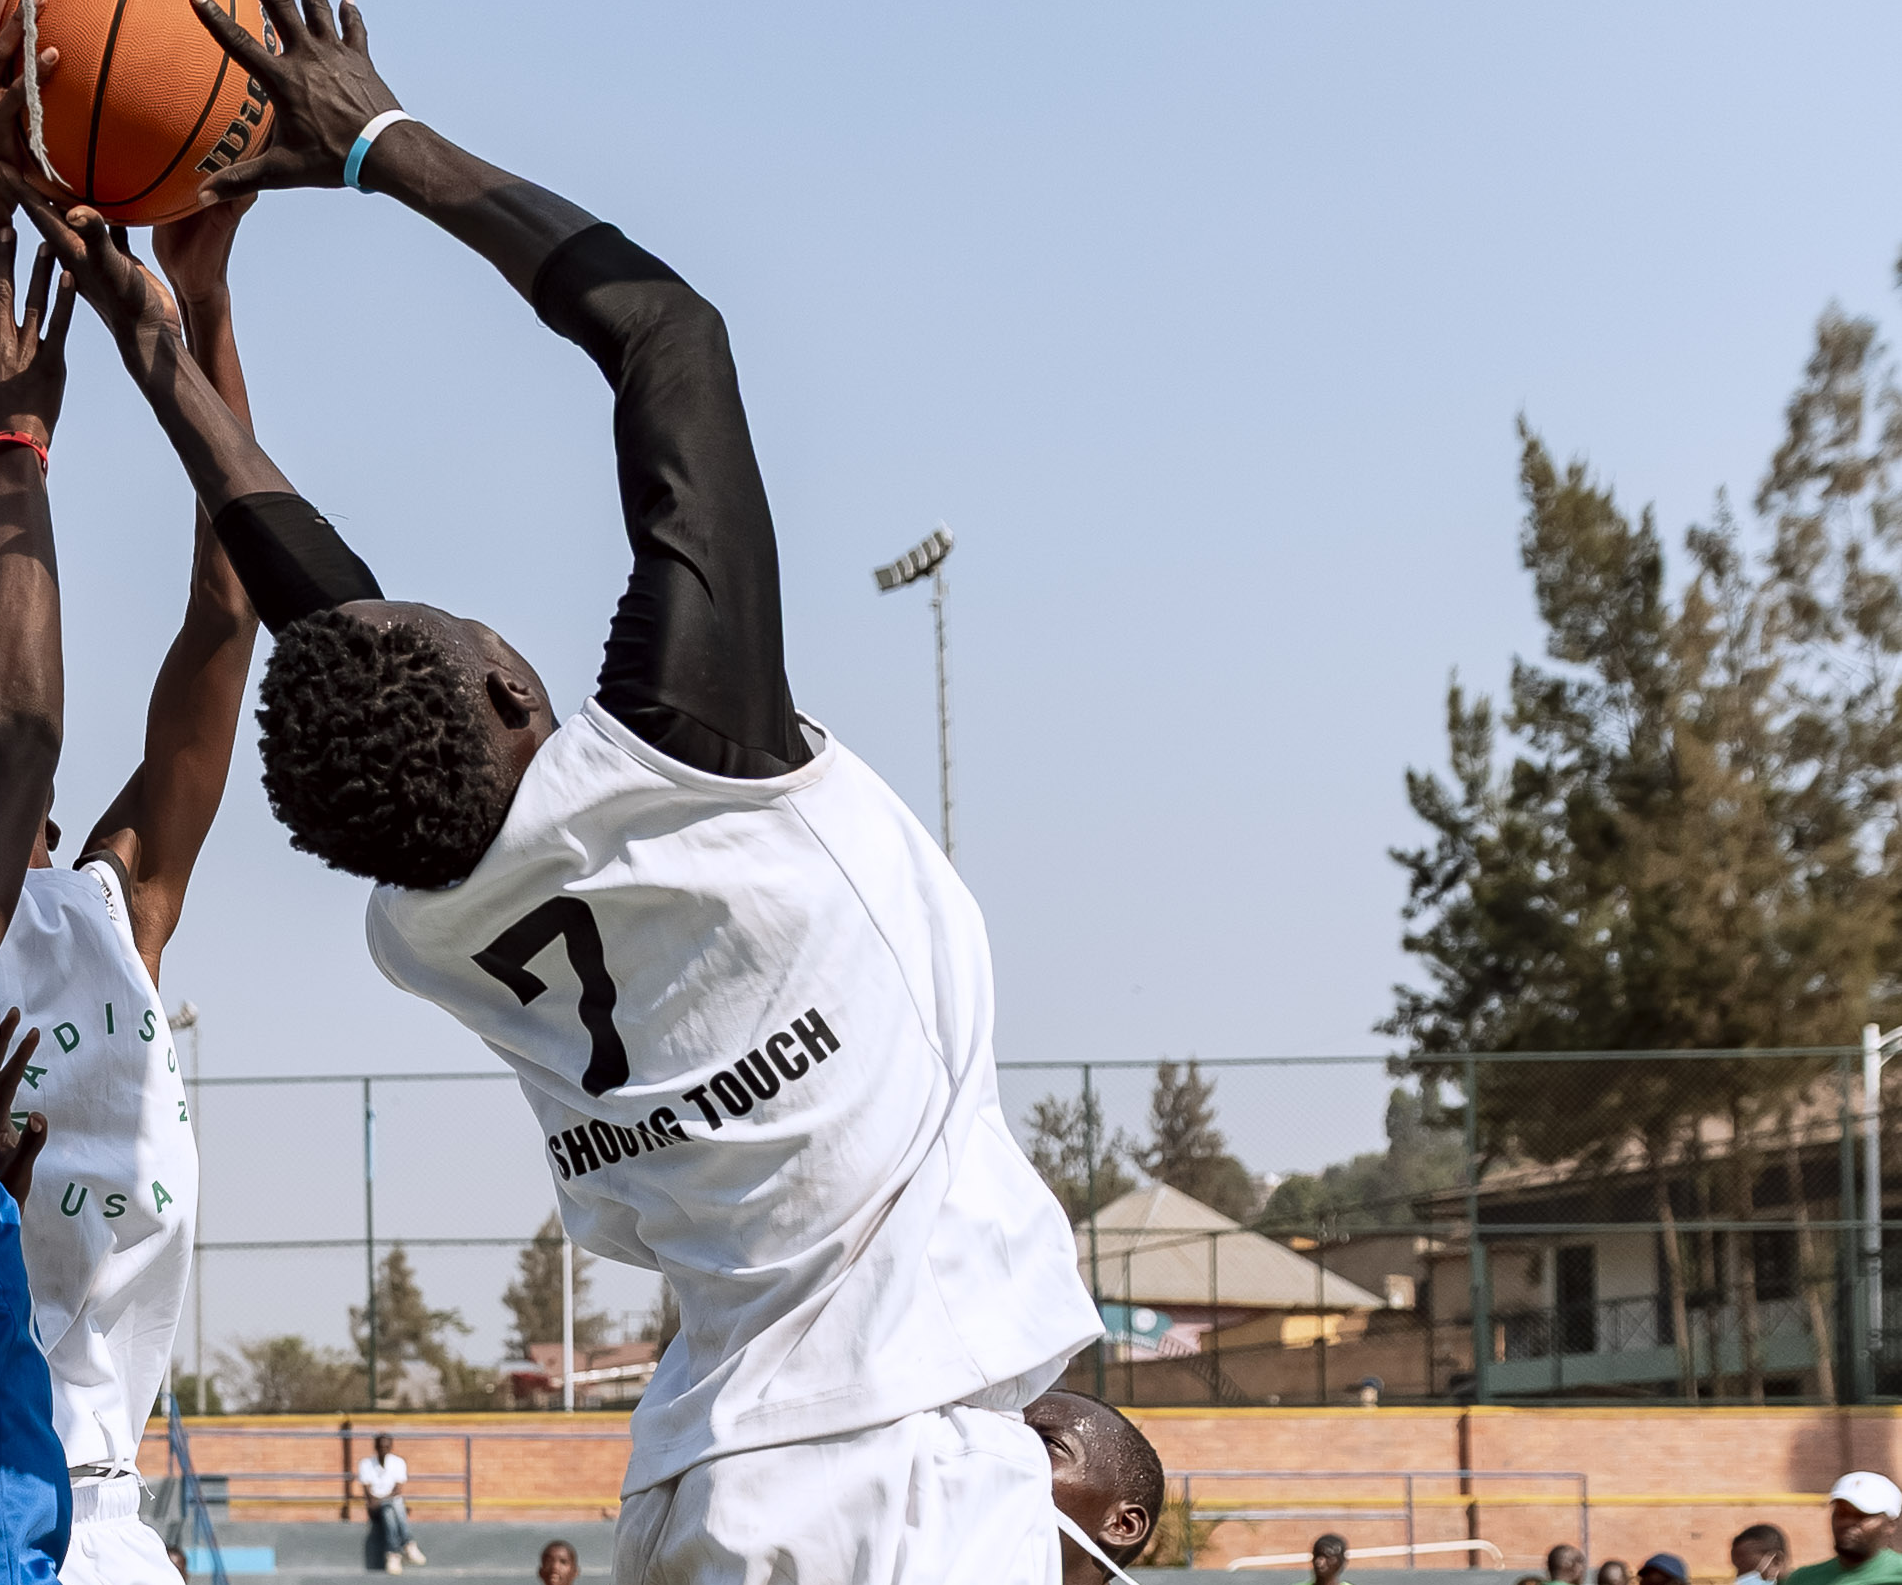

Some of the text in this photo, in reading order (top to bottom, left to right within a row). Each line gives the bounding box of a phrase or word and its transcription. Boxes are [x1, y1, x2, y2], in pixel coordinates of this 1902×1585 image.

[470, 896, 630, 1098] 7
[681, 1007, 841, 1131] TOUCH
[60, 1181, 173, 1219] USA
